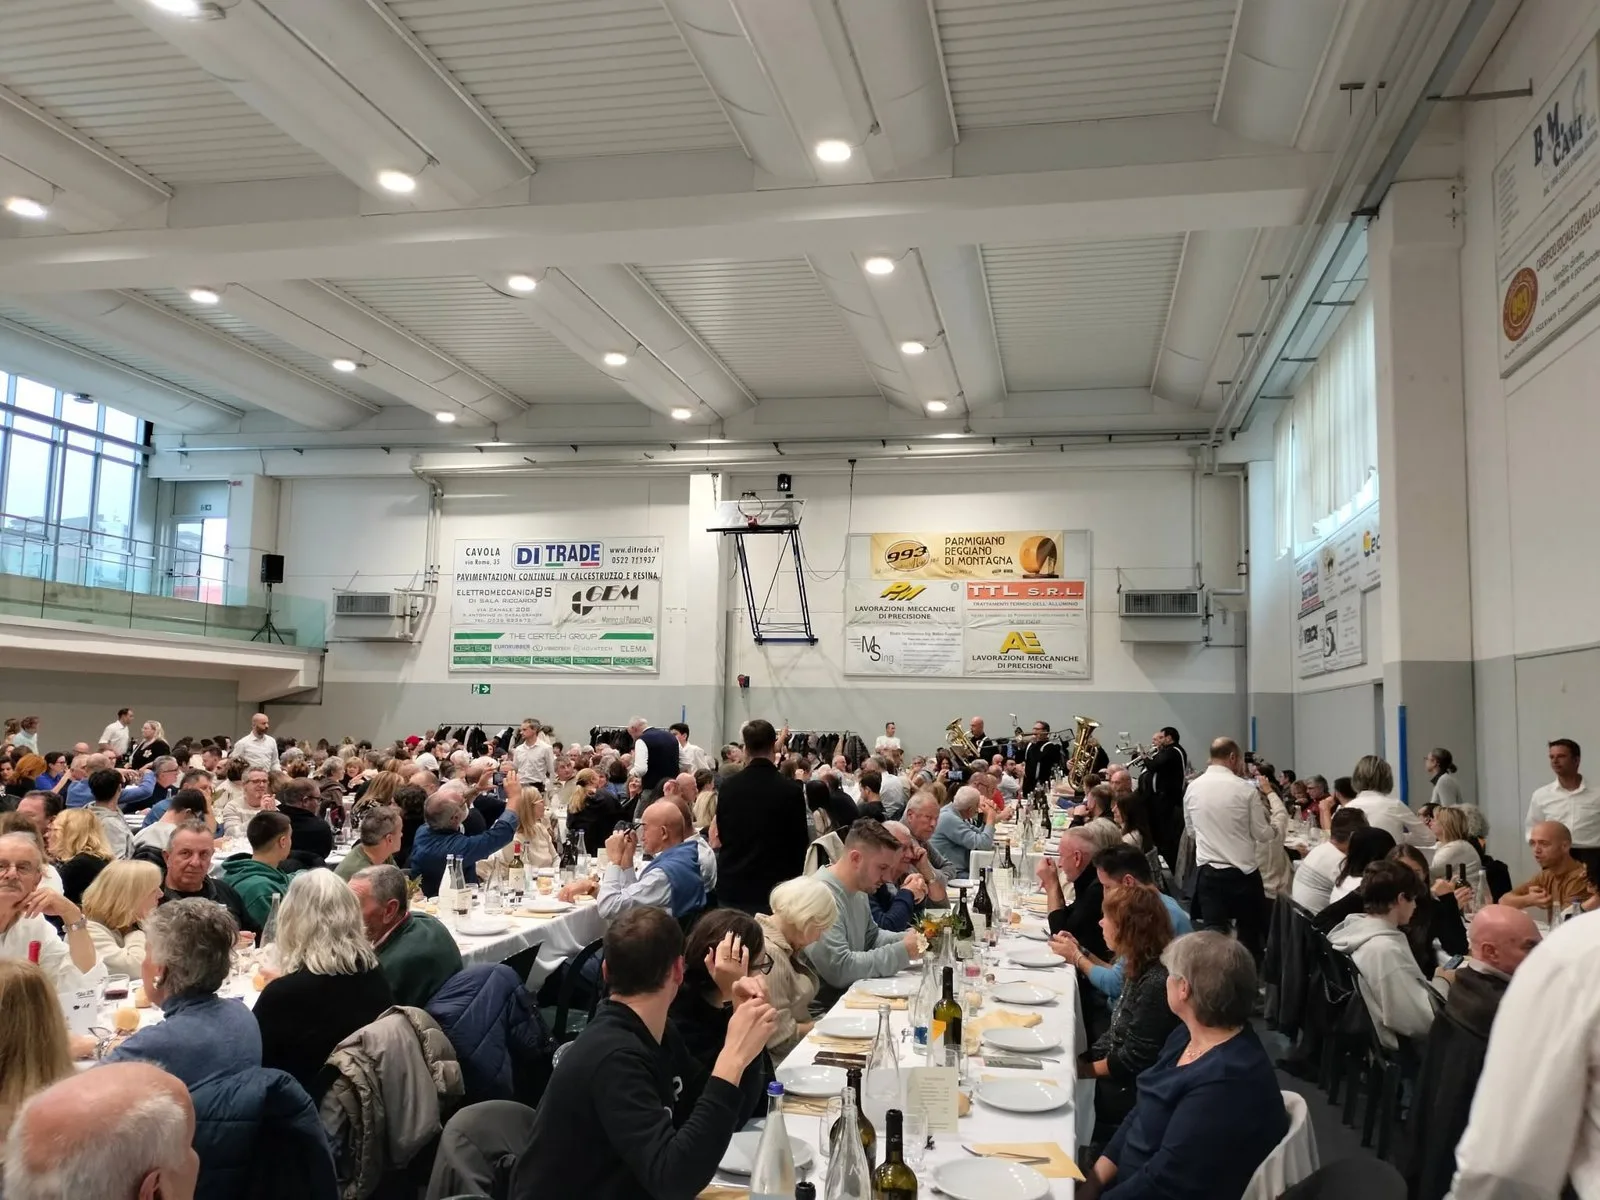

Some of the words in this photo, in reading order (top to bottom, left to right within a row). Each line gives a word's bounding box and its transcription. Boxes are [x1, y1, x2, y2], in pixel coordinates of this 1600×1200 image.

[944, 536, 1006, 546] PARMIGIANO
[465, 547, 501, 557] CAVOLA
[516, 547, 540, 565] DI
[545, 543, 601, 563] TRADE
[609, 545, 661, 554] www.ditrade.it
[944, 546, 992, 556] REGGIANO
[886, 546, 928, 564] 993
[493, 558, 501, 566] 35
[611, 556, 629, 565] 0522
[944, 556, 956, 566] DI
[957, 556, 1013, 566] MONTAGNA
[456, 572, 516, 582] PAVIMENTAZIONI
[518, 572, 556, 582] CONTINUE
[559, 572, 568, 581] IN
[570, 571, 624, 581] CALCESTRUZZO
[626, 571, 631, 580] E
[632, 571, 659, 580] RESINA
[968, 585, 1020, 597] TTL
[1027, 587, 1083, 597] S.R.L.
[972, 654, 1025, 662] LAVORAZIONI
[1027, 655, 1080, 663] MECCANICHE
[1007, 662, 1053, 670] PRECISIONE
